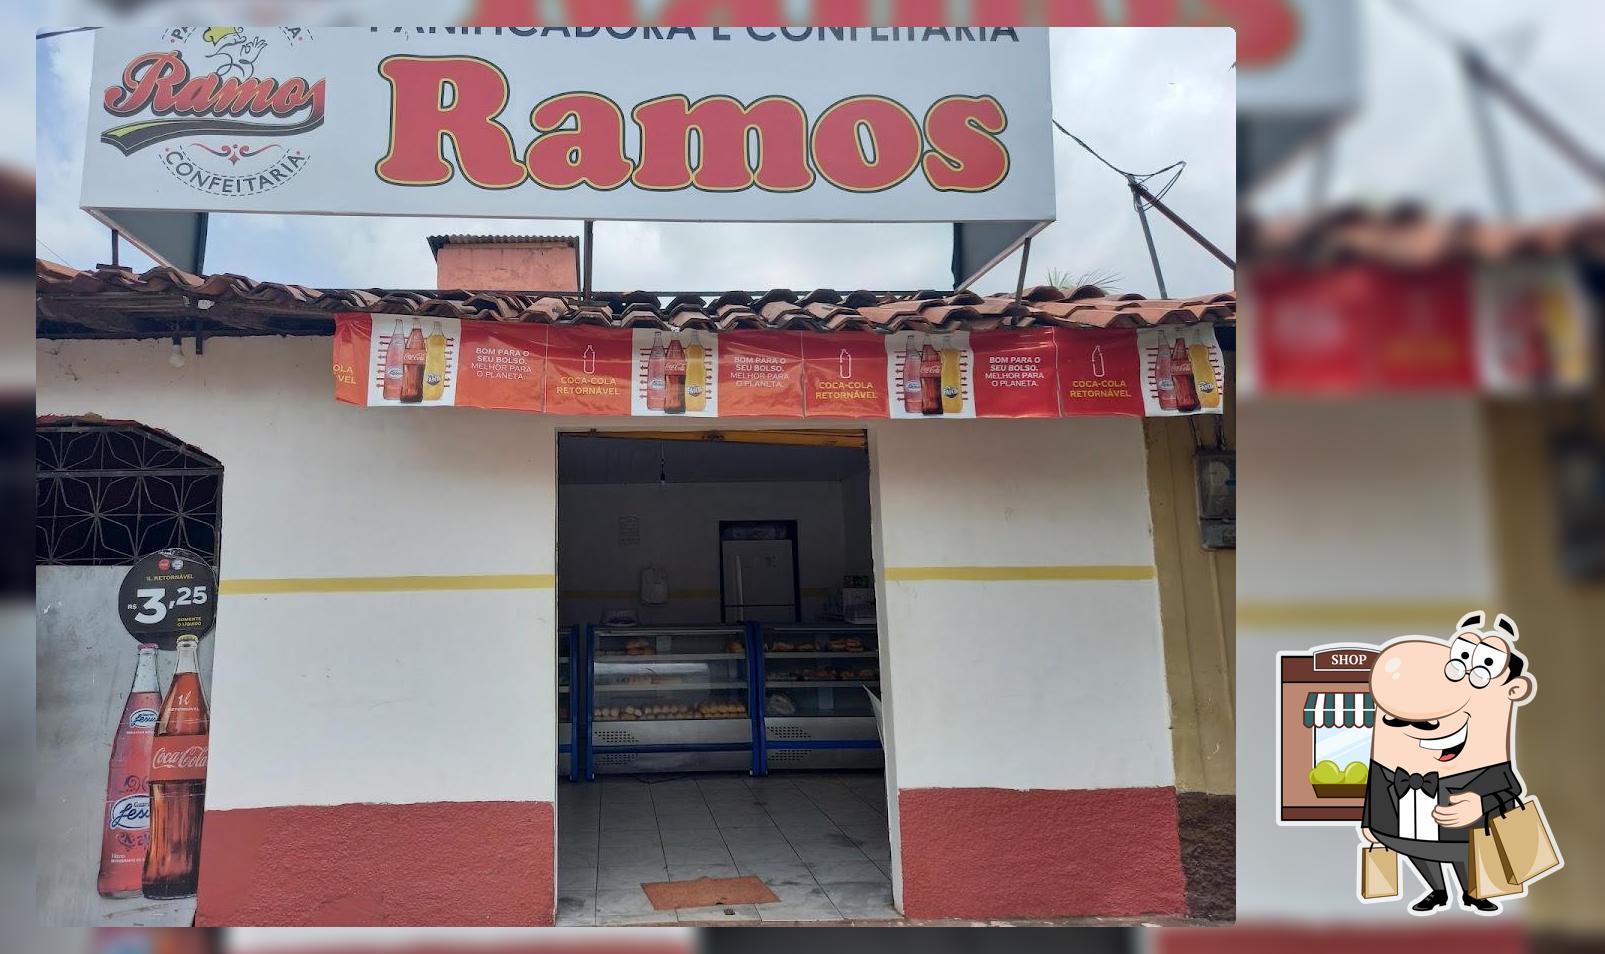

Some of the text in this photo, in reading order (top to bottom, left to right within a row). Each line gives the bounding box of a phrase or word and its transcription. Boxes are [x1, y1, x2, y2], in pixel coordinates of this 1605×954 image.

[374, 53, 1011, 194] Ramos
[166, 151, 305, 193] CONFEITARIA
[476, 347, 496, 355] BOM
[498, 349, 521, 357] PARA
[477, 355, 527, 365] SEU BOLSO.
[734, 356, 752, 364] BOM
[989, 356, 1008, 364] BOM
[1010, 356, 1033, 364] PARA
[471, 362, 532, 373] MELHOR PARA
[753, 364, 785, 372] BOLSO.
[1008, 364, 1039, 372] BOLSO.
[485, 372, 525, 380] PLANETA.
[560, 376, 616, 385] COCA-COLA
[730, 372, 765, 380] MELHOR
[818, 381, 873, 389] COCA-COLA
[1072, 380, 1127, 388] COCA-COLA
[556, 385, 620, 395] RETORNÁVEL
[815, 389, 878, 399] RETORNÁVEL
[1069, 388, 1131, 398] RETORNÁVEL
[134, 586, 208, 624] 3,25
